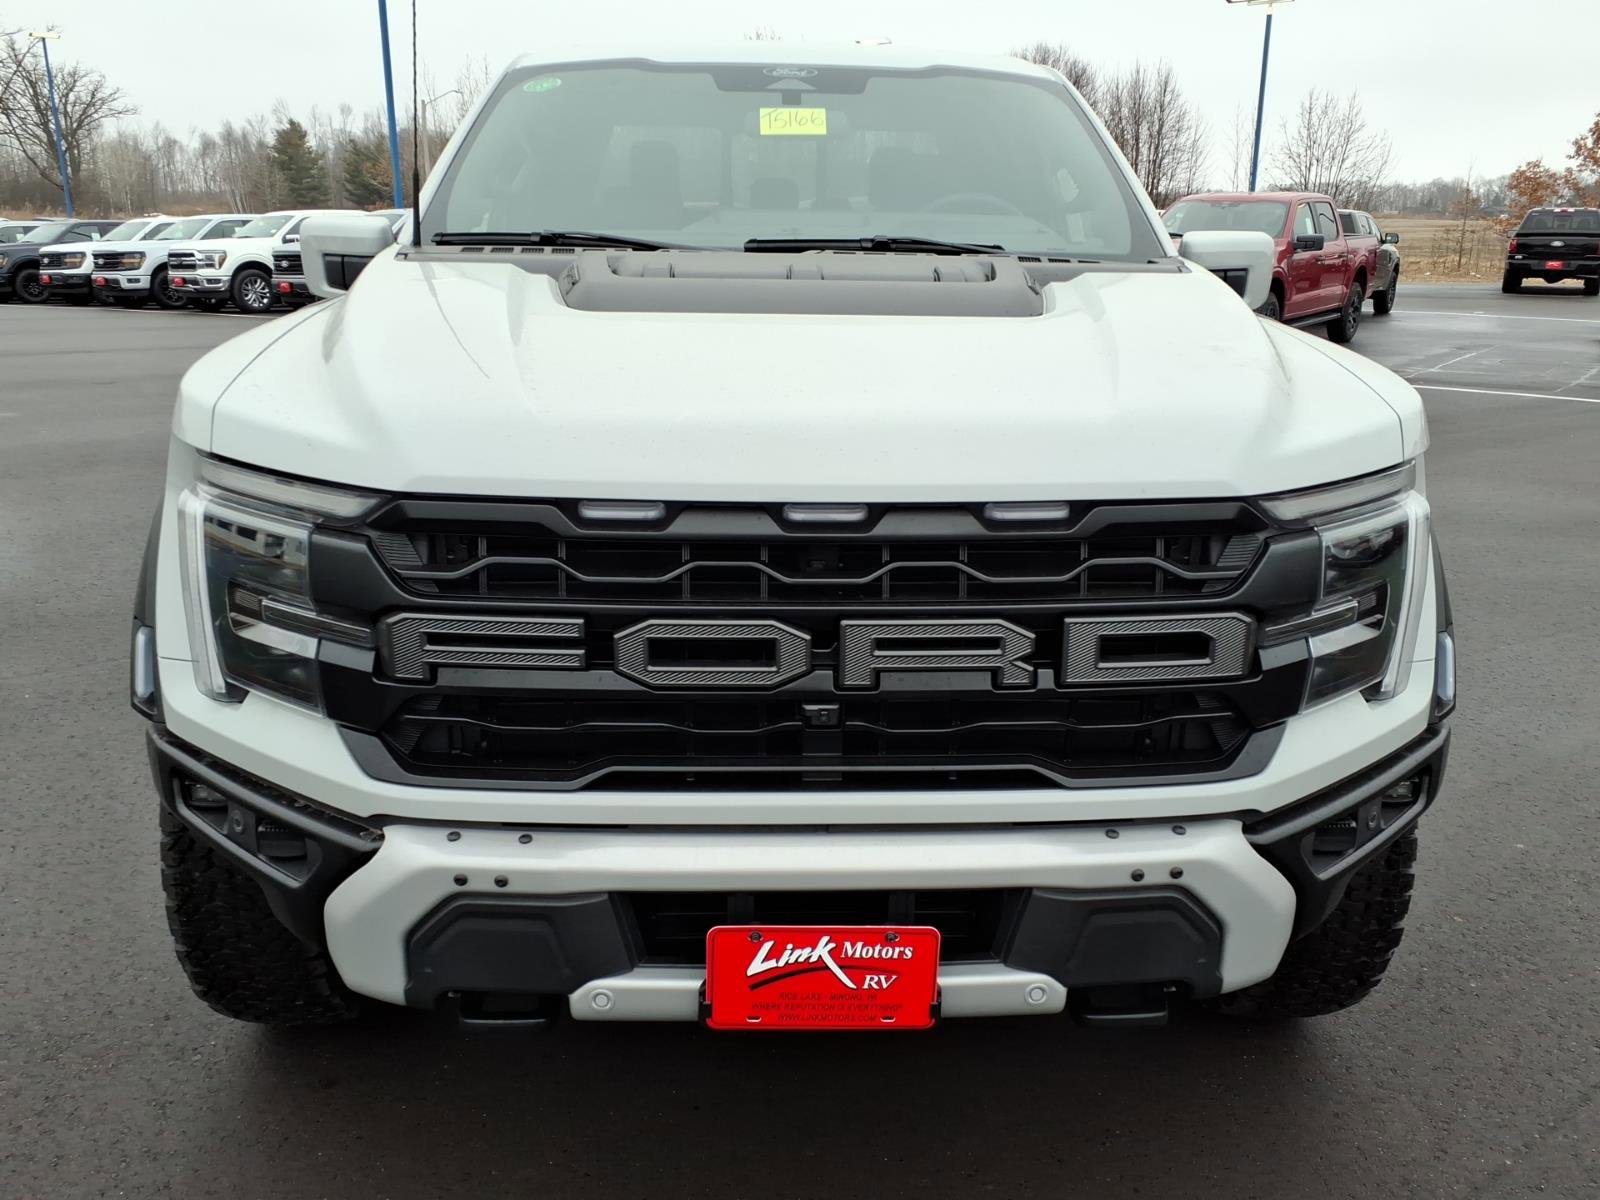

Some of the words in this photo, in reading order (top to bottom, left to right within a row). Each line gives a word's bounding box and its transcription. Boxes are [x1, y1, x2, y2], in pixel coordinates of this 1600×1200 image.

[381, 611, 1258, 687] FORD
[746, 936, 857, 989] Link
[840, 941, 913, 959] Motors
[862, 974, 898, 989] RV
